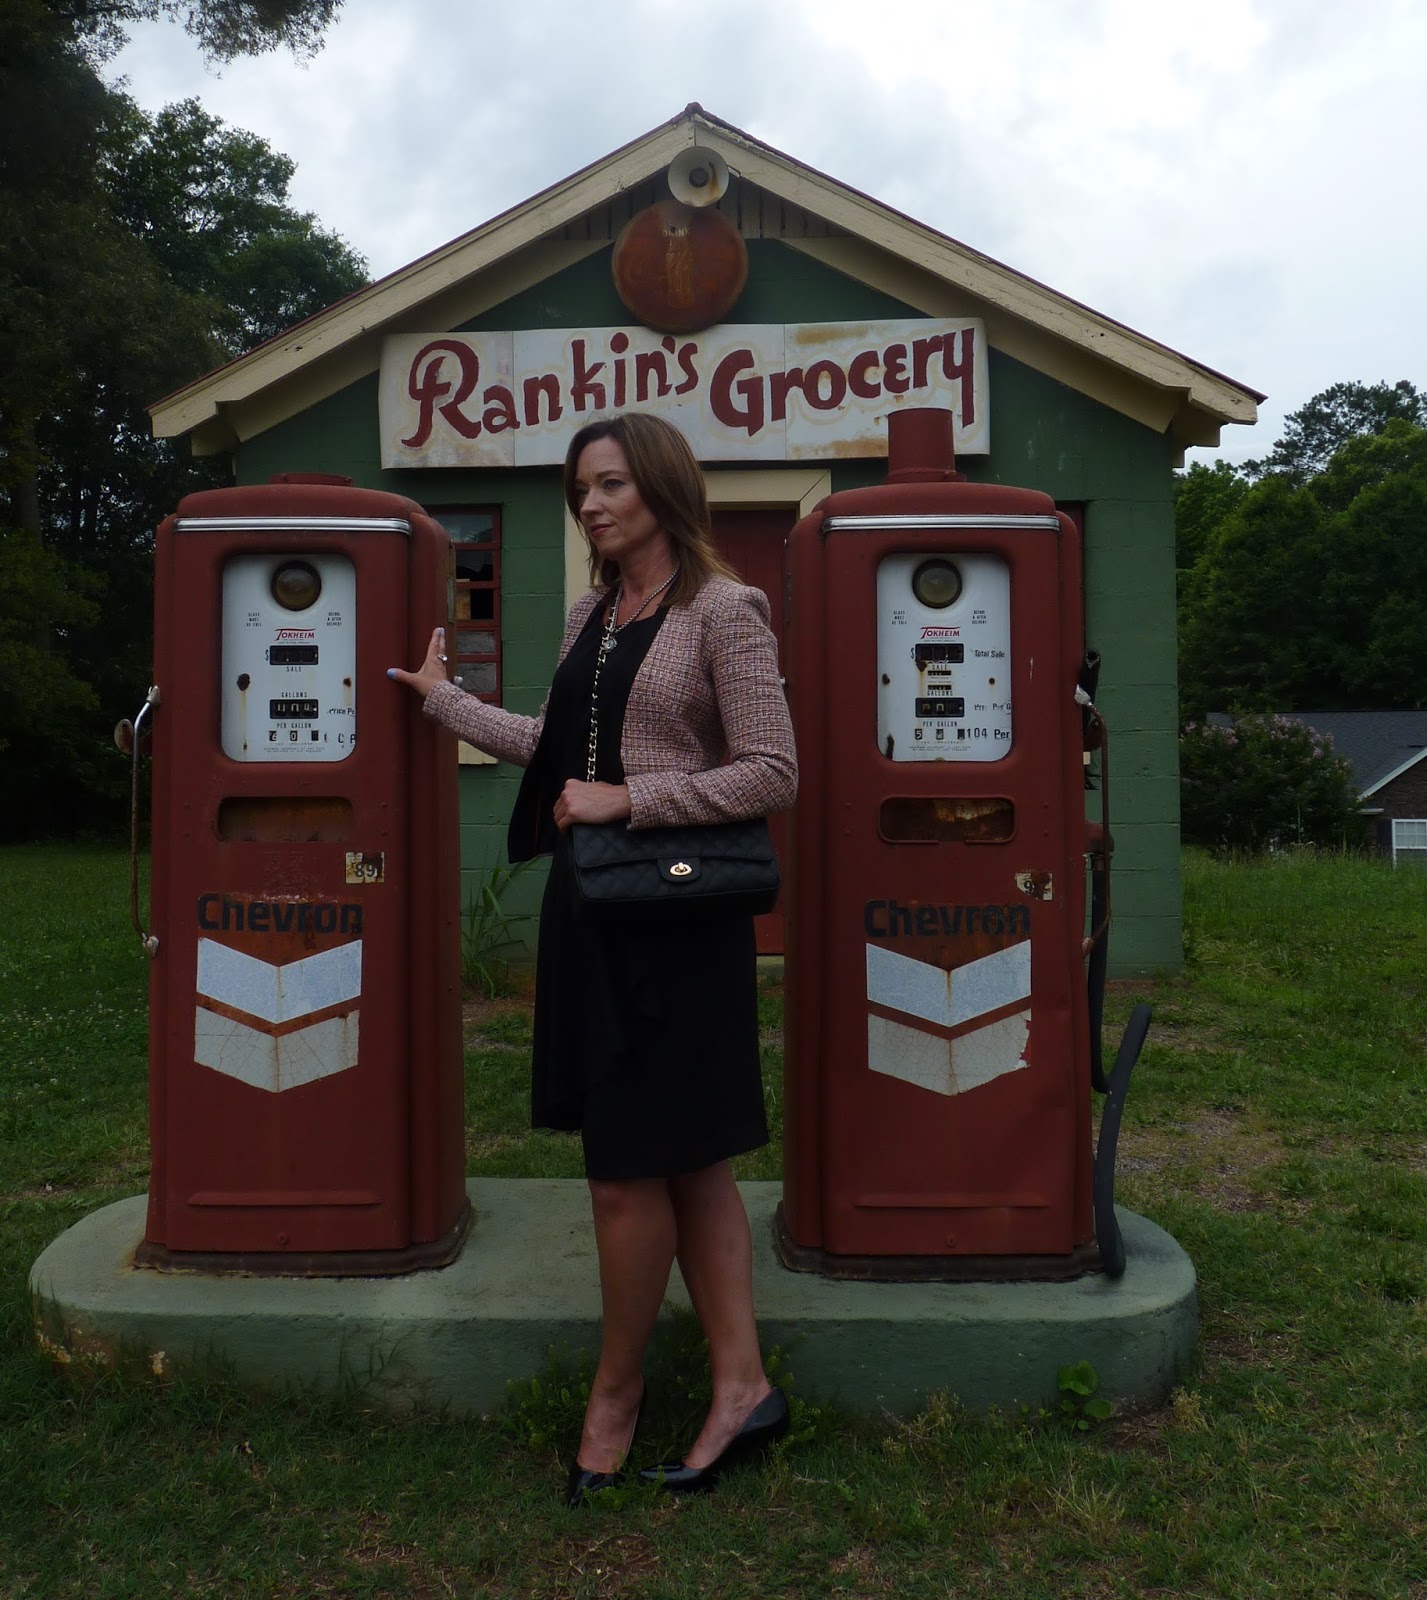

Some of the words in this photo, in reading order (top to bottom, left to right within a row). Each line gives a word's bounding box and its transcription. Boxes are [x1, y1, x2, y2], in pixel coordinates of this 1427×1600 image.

[401, 331, 699, 448] Rankin's
[709, 327, 976, 437] Grocery
[275, 628, 316, 641] TOKHEIM
[920, 626, 961, 639] TOKHEIM
[994, 729, 1010, 739] Per
[197, 893, 363, 934] Chevron
[864, 900, 1031, 937] Chevron
